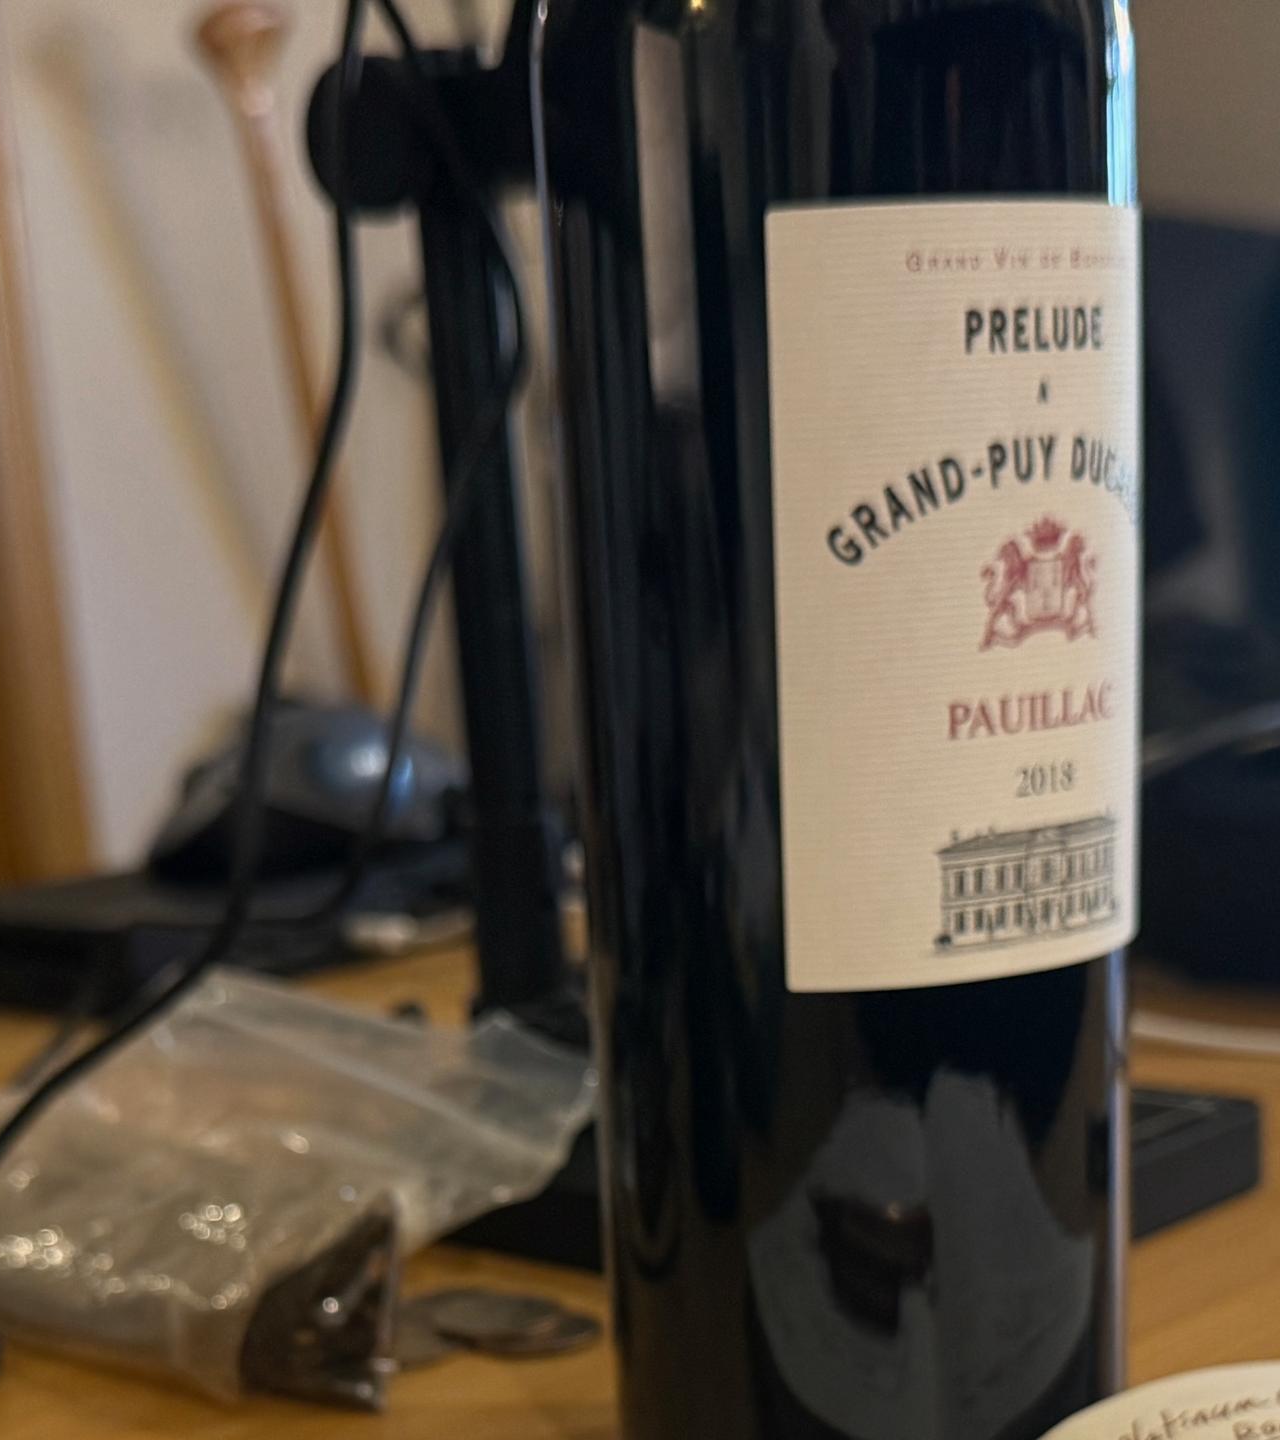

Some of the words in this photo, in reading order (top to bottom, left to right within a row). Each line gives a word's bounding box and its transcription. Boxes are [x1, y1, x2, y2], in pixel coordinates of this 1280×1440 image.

[964, 306, 1104, 356] PRELUDE
[826, 434, 1057, 568] GRAND-PUY
[947, 684, 1114, 740] PAUILLAC
[1015, 760, 1076, 798] 2018
